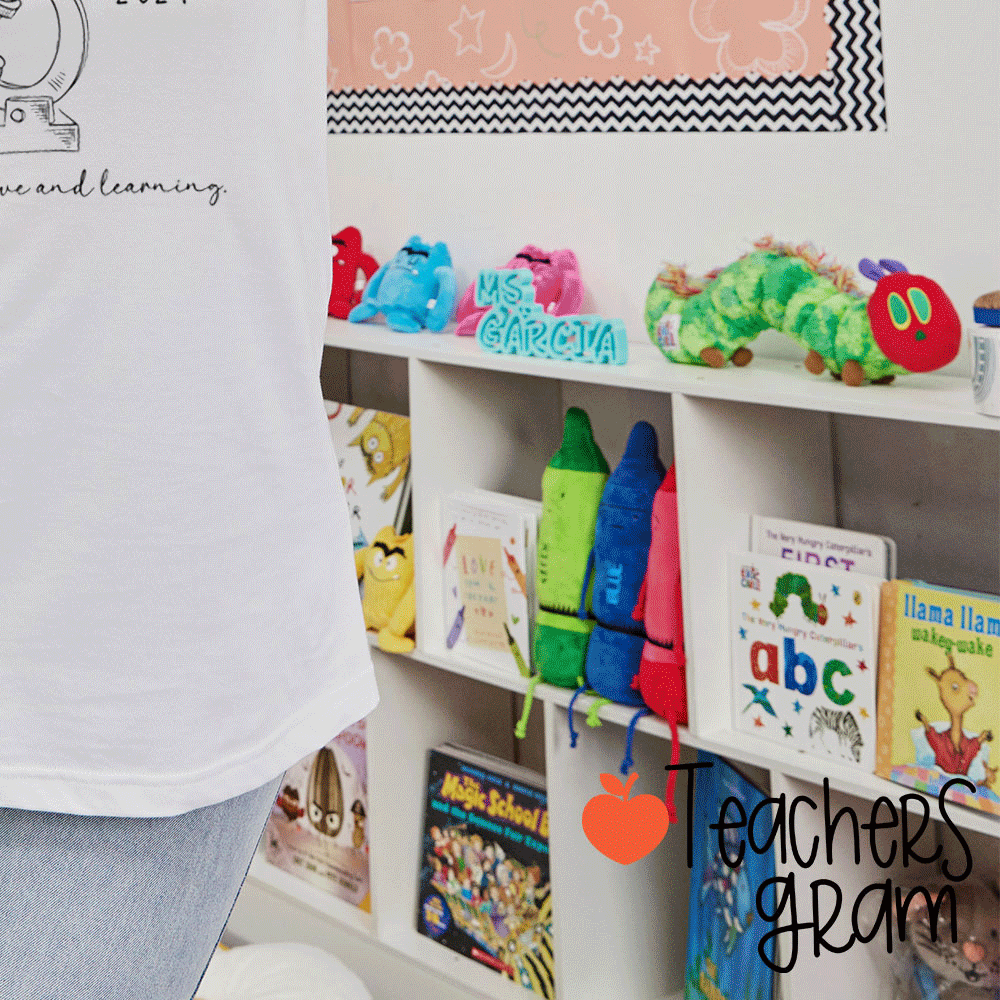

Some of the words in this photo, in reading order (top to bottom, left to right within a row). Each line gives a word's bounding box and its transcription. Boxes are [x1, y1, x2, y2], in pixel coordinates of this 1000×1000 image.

[36, 168, 94, 198] and
[99, 168, 228, 206] learning.
[480, 309, 618, 366] GARCIA
[905, 593, 954, 627] llama
[961, 605, 1000, 637] llam
[911, 626, 994, 658] wakey-wake
[750, 636, 856, 706] abc
[487, 789, 541, 833] School
